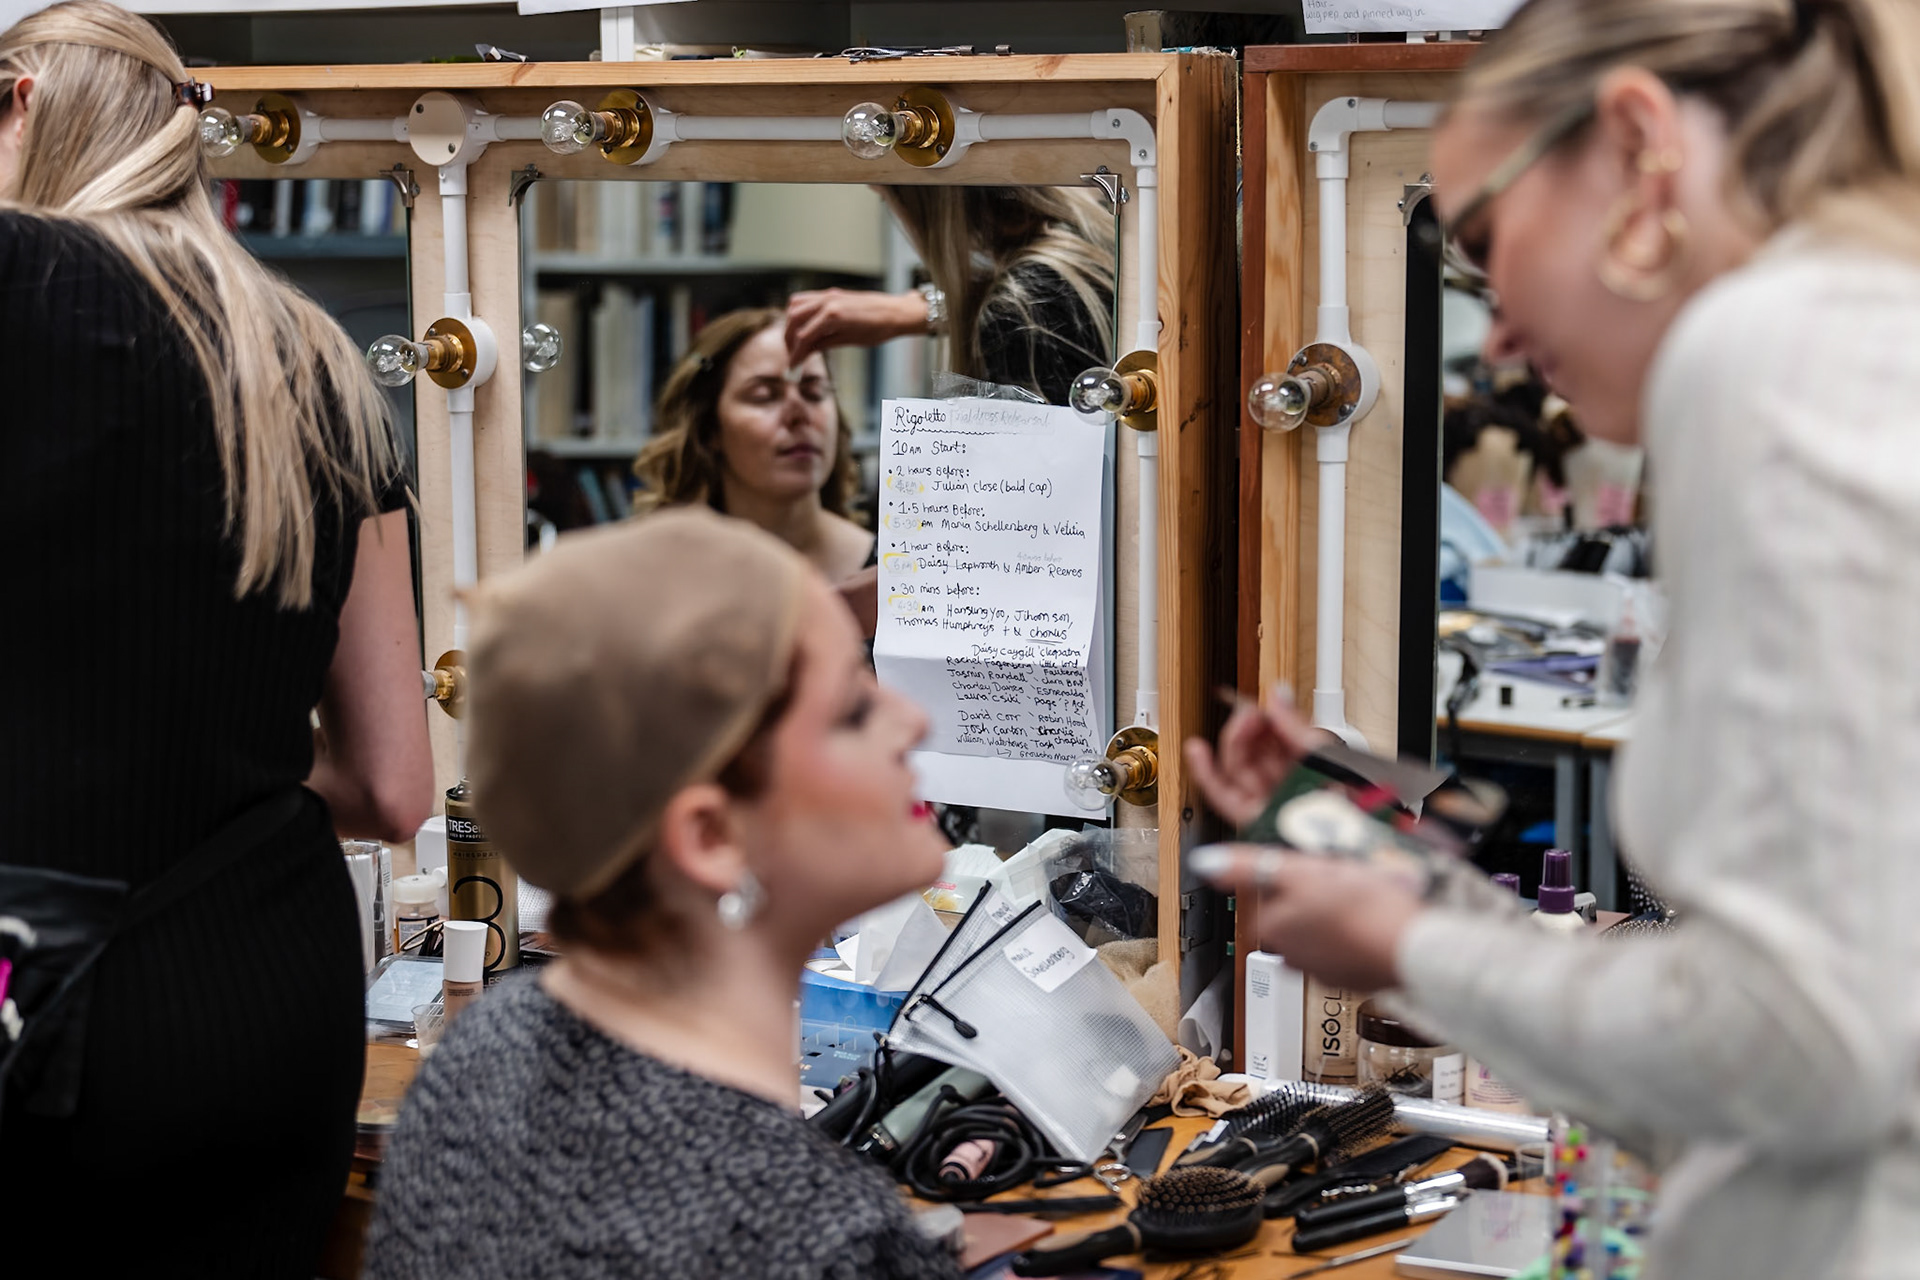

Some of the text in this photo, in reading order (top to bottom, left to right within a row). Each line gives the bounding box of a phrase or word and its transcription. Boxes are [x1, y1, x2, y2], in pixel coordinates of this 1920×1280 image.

[895, 406, 946, 435] Rigoletto
[931, 479, 969, 493] Julian
[941, 517, 971, 531] Maria
[974, 520, 1038, 539] Schellenberg
[917, 555, 948, 574] Daisy
[1015, 562, 1045, 574] Amber
[1047, 563, 1083, 578] Reeves
[901, 583, 915, 595] 30
[920, 582, 940, 595] mins
[895, 617, 938, 627] Thomas
[957, 708, 993, 721] David
[447, 818, 484, 834] TRESe
